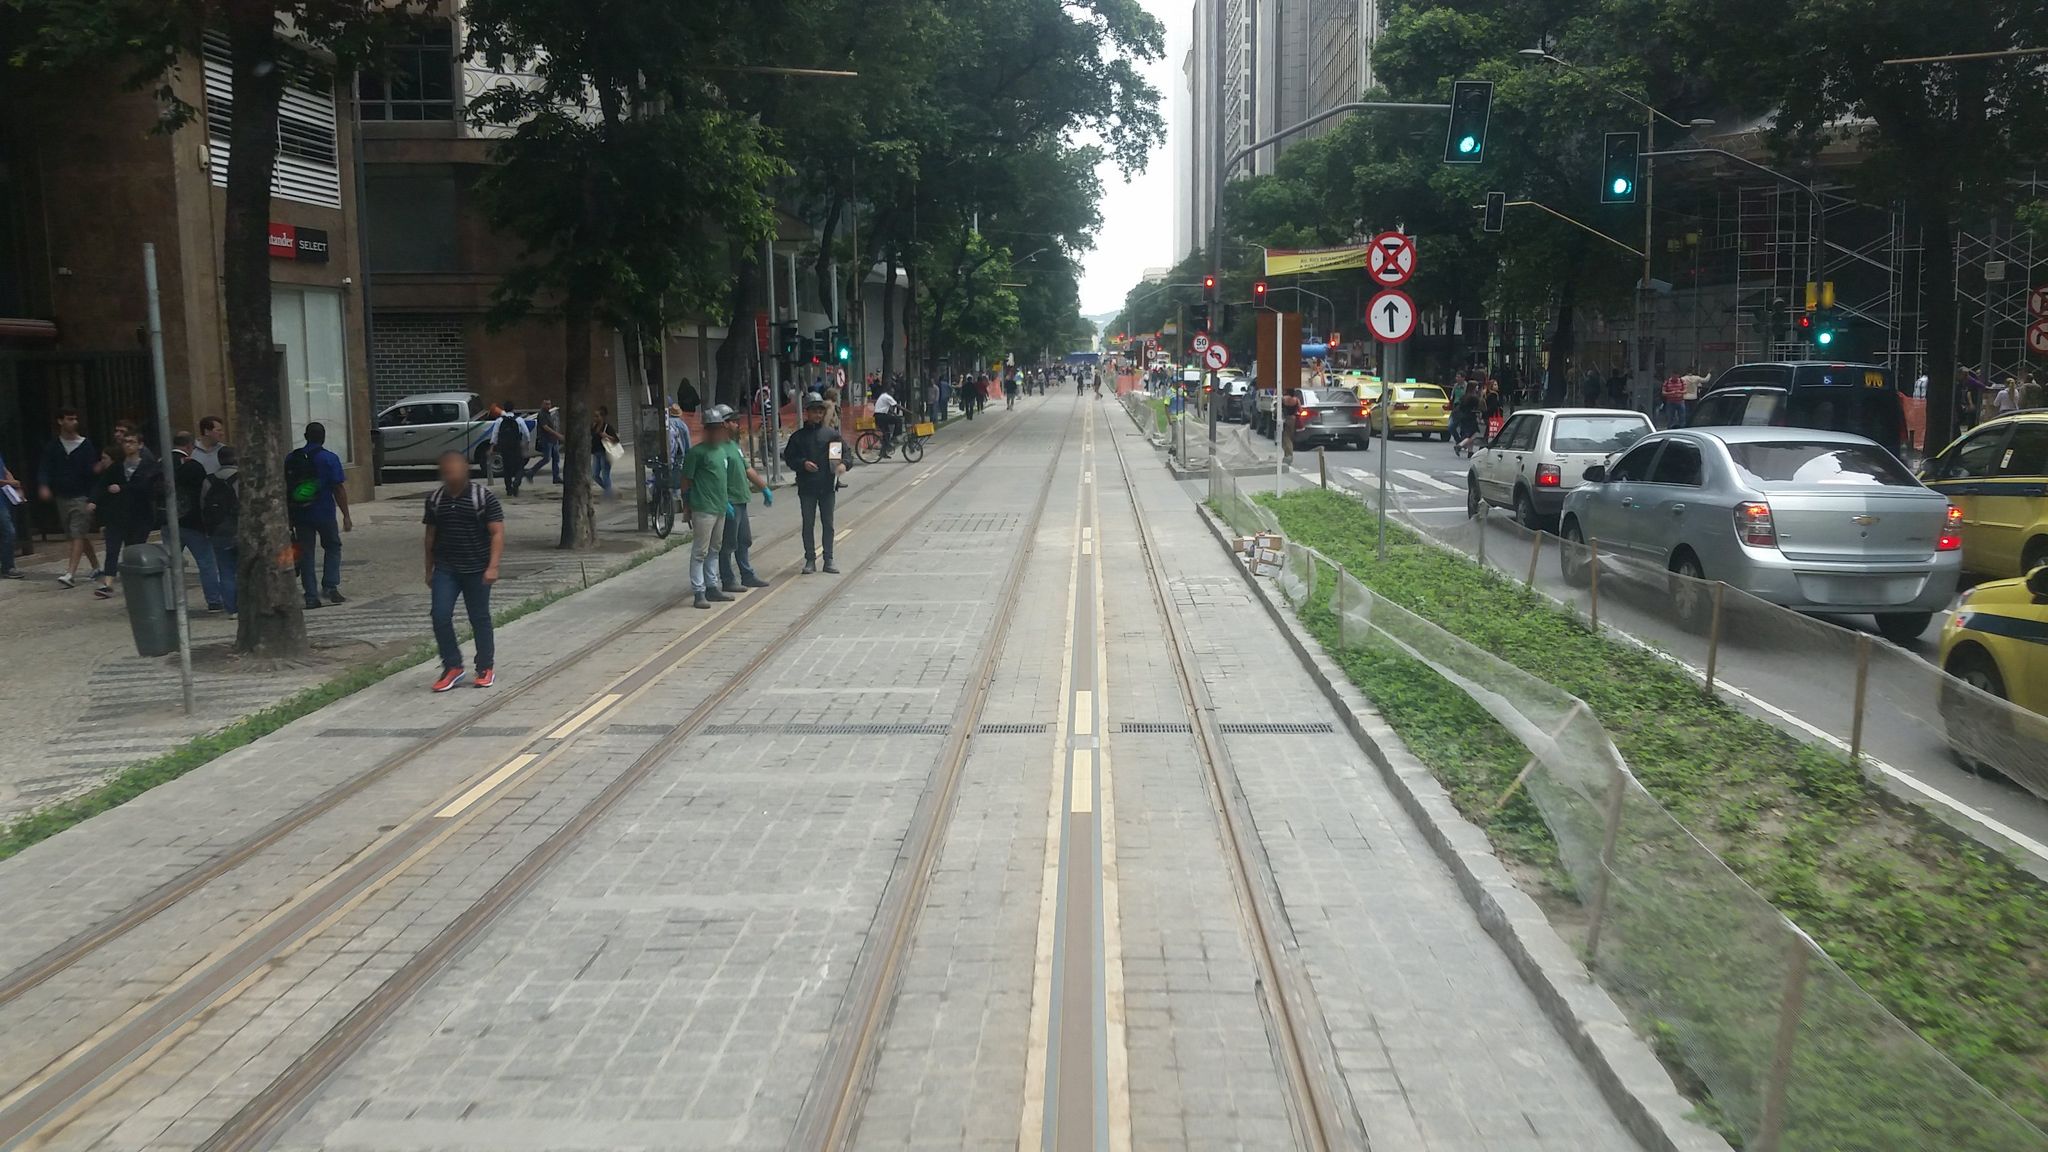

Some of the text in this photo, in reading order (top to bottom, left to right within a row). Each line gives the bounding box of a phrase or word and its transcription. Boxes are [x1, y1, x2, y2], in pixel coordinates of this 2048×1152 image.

[268, 232, 327, 252] tander SELECT
[1196, 338, 1207, 346] 50
